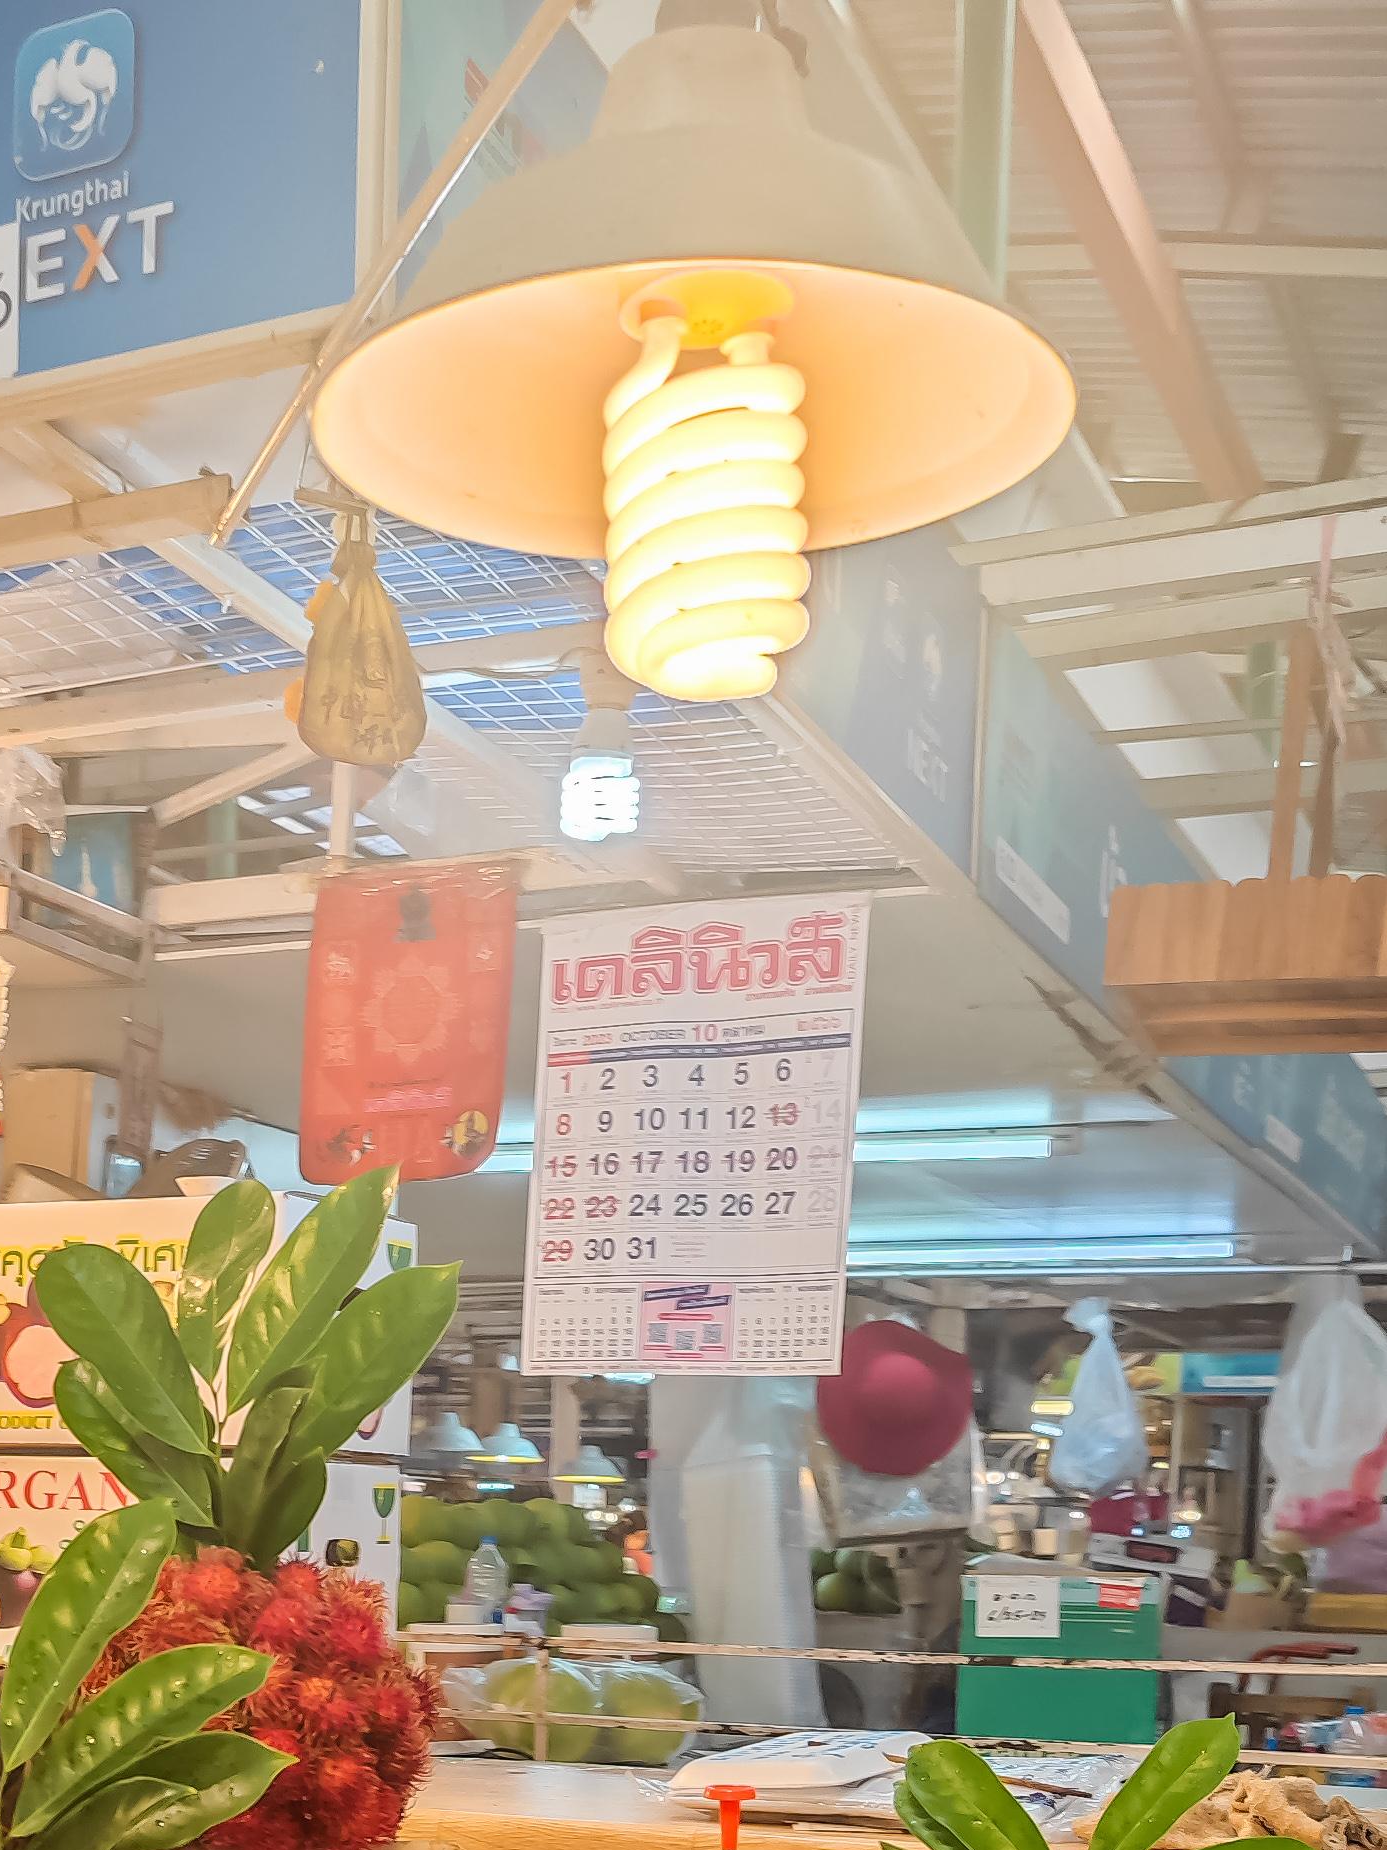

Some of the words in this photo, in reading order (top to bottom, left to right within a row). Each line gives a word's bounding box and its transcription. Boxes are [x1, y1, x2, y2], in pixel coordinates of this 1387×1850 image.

[15, 169, 131, 223] Krungthai
[619, 1029, 687, 1043] OCTOBER
[692, 1024, 719, 1042] 10
[563, 1071, 571, 1093] 1
[600, 1068, 615, 1090] 2
[643, 1065, 659, 1087] 3
[688, 1064, 704, 1086] 4
[734, 1062, 749, 1085] 5
[776, 1058, 790, 1082] 6
[556, 1113, 571, 1136] 8
[597, 1110, 612, 1132] 9
[634, 1107, 665, 1130] 10
[679, 1107, 709, 1130] 11
[725, 1105, 756, 1129] 12
[548, 1155, 577, 1178] 15
[588, 1152, 619, 1176] 16
[633, 1150, 663, 1173] 17
[678, 1150, 710, 1173] 18
[724, 1149, 756, 1173] 19
[628, 1193, 662, 1217] 24
[674, 1193, 708, 1217] 25
[720, 1193, 753, 1217] 26
[765, 1191, 797, 1215] 27
[584, 1238, 615, 1261] 30
[627, 1237, 657, 1259] 31
